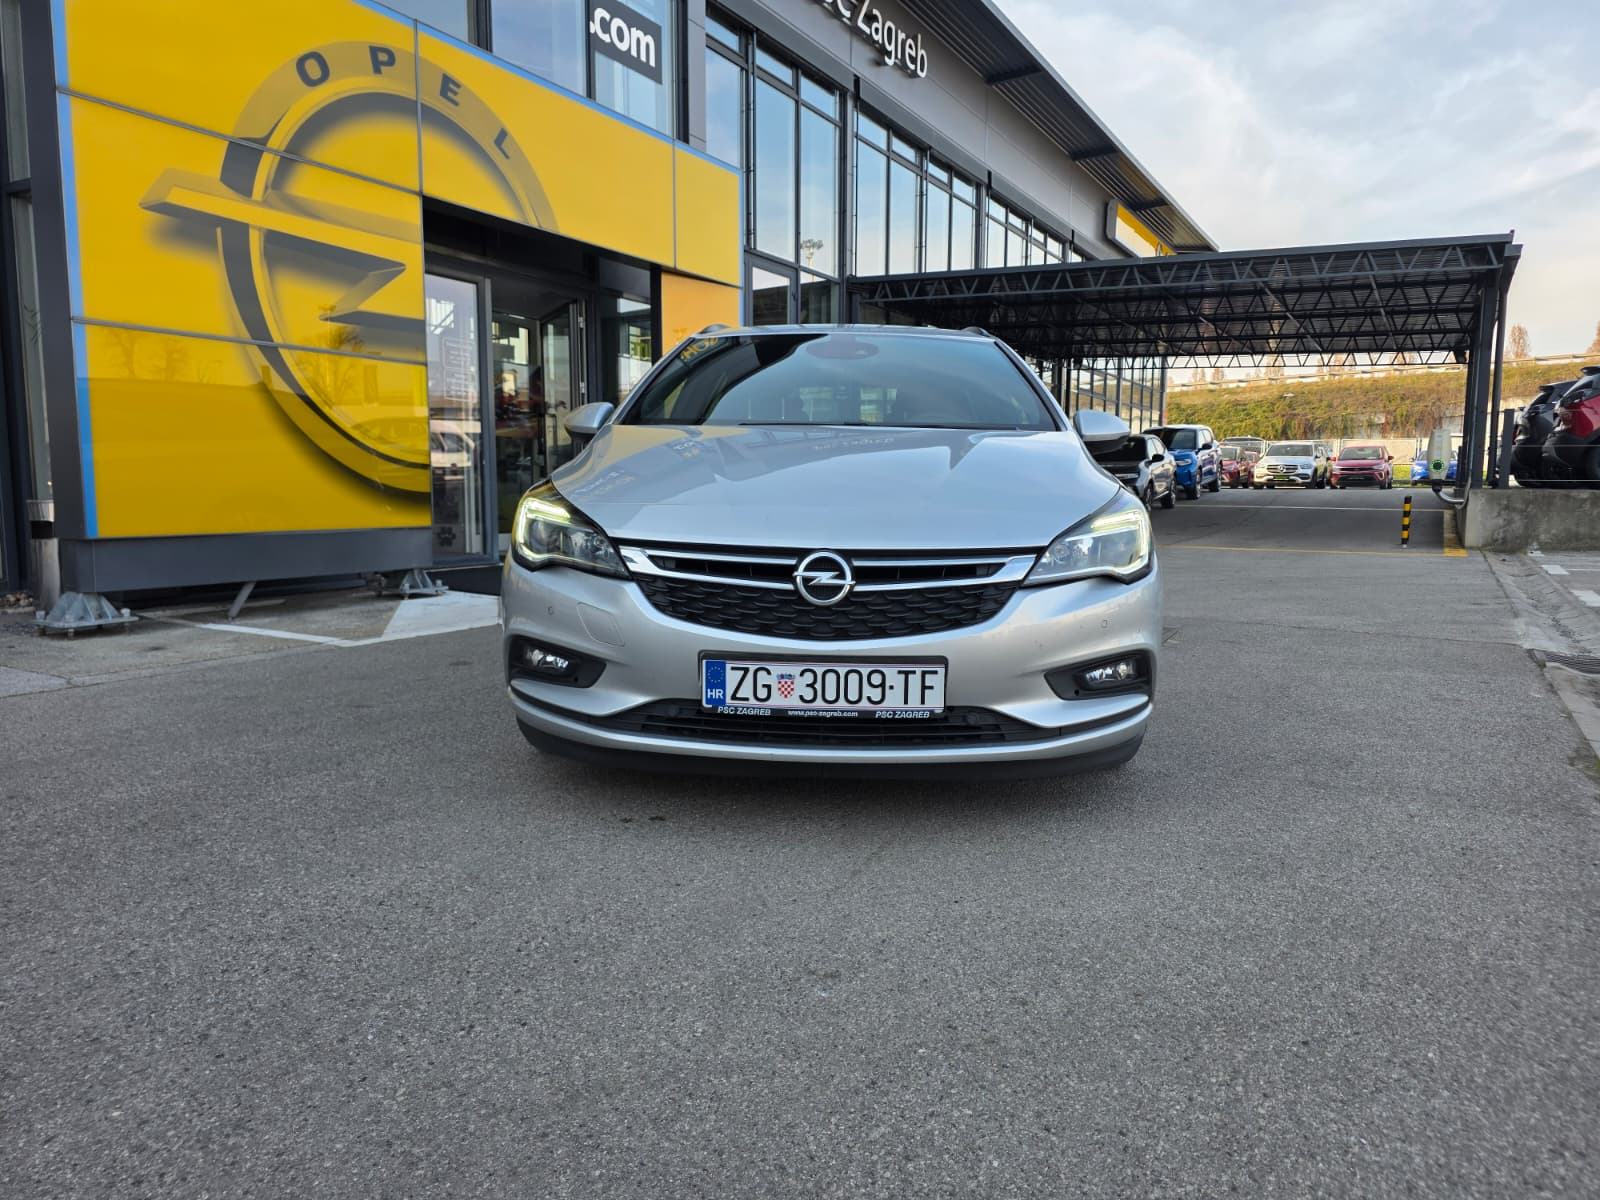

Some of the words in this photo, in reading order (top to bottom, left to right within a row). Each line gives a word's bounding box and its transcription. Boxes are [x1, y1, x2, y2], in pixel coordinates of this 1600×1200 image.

[857, 0, 927, 78] Zagreb
[295, 45, 511, 160] OPEL
[707, 688, 724, 699] HR
[730, 666, 772, 702] ZG
[718, 706, 735, 714] PSC
[736, 706, 771, 716] ZAGREB
[875, 711, 894, 719] PSC
[895, 711, 930, 719] ZAGREB
